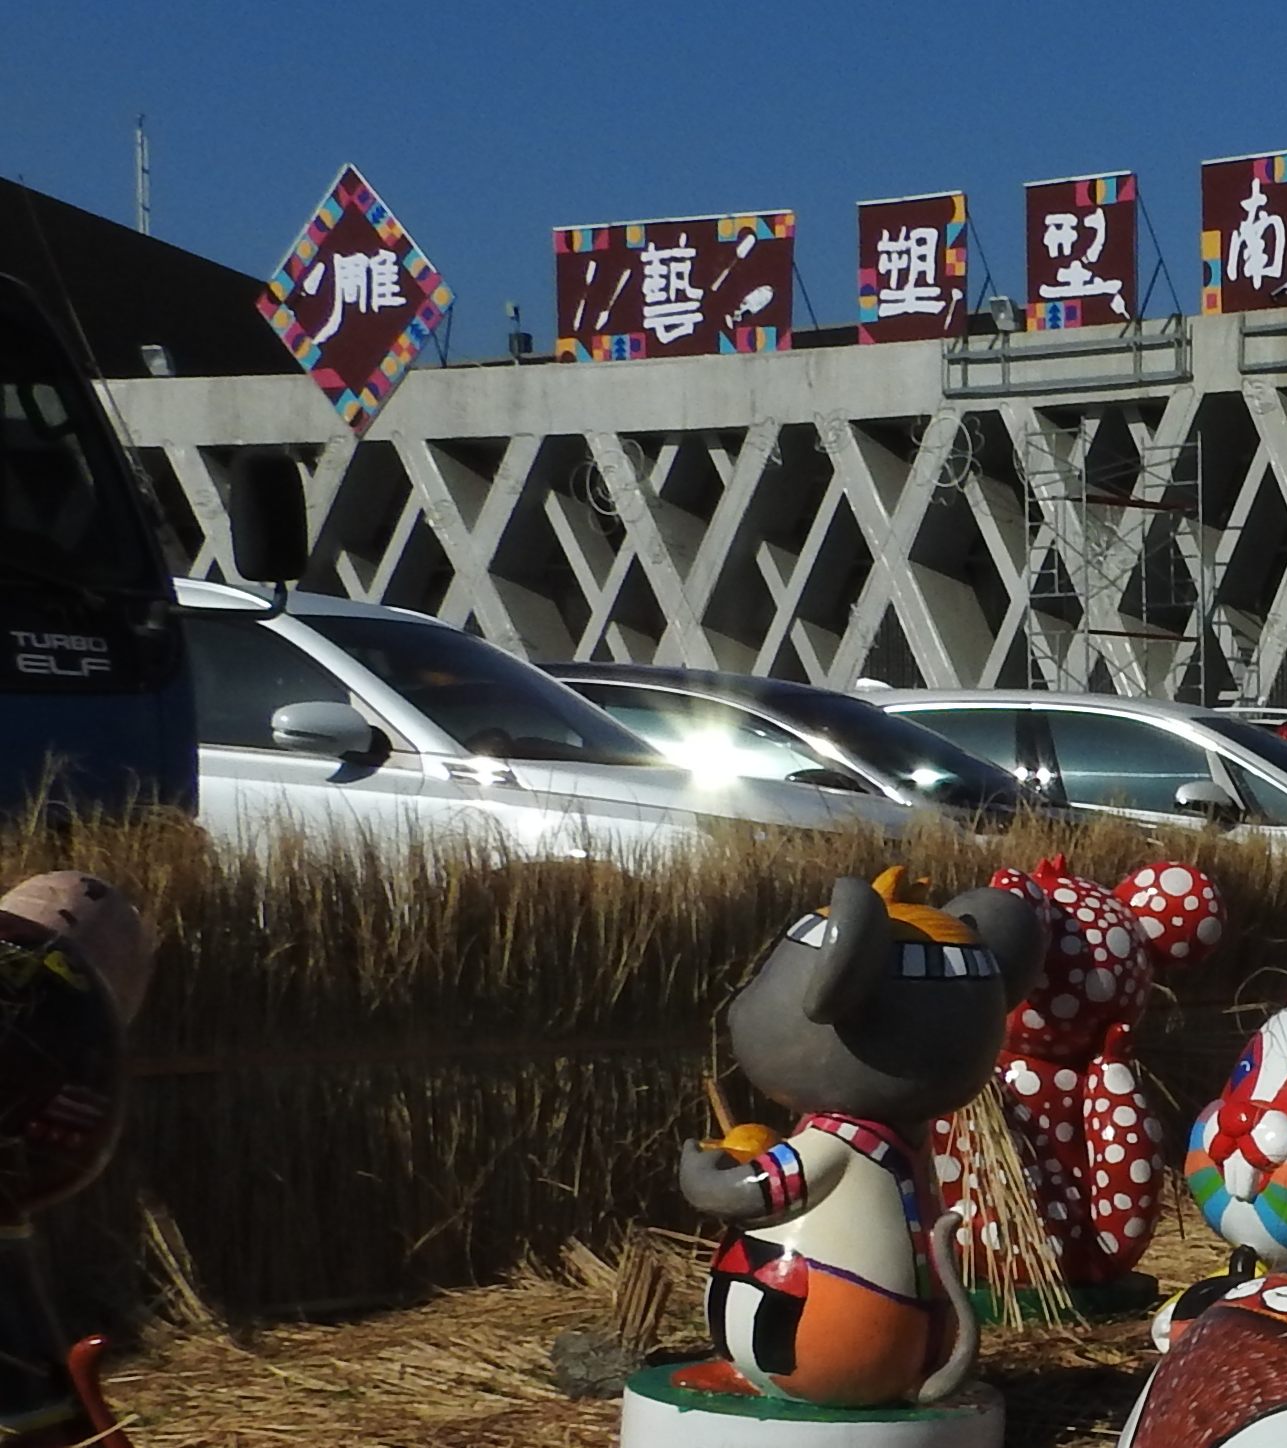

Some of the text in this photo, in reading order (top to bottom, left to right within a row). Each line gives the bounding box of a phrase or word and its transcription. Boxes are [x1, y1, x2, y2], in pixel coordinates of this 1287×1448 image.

[877, 225, 946, 317] 塑
[1040, 207, 1123, 299] 型
[1227, 177, 1286, 290] 南
[312, 249, 407, 345] 雕
[640, 232, 704, 344] 藝
[9, 630, 108, 652] TURBO
[16, 653, 112, 677] ELF
